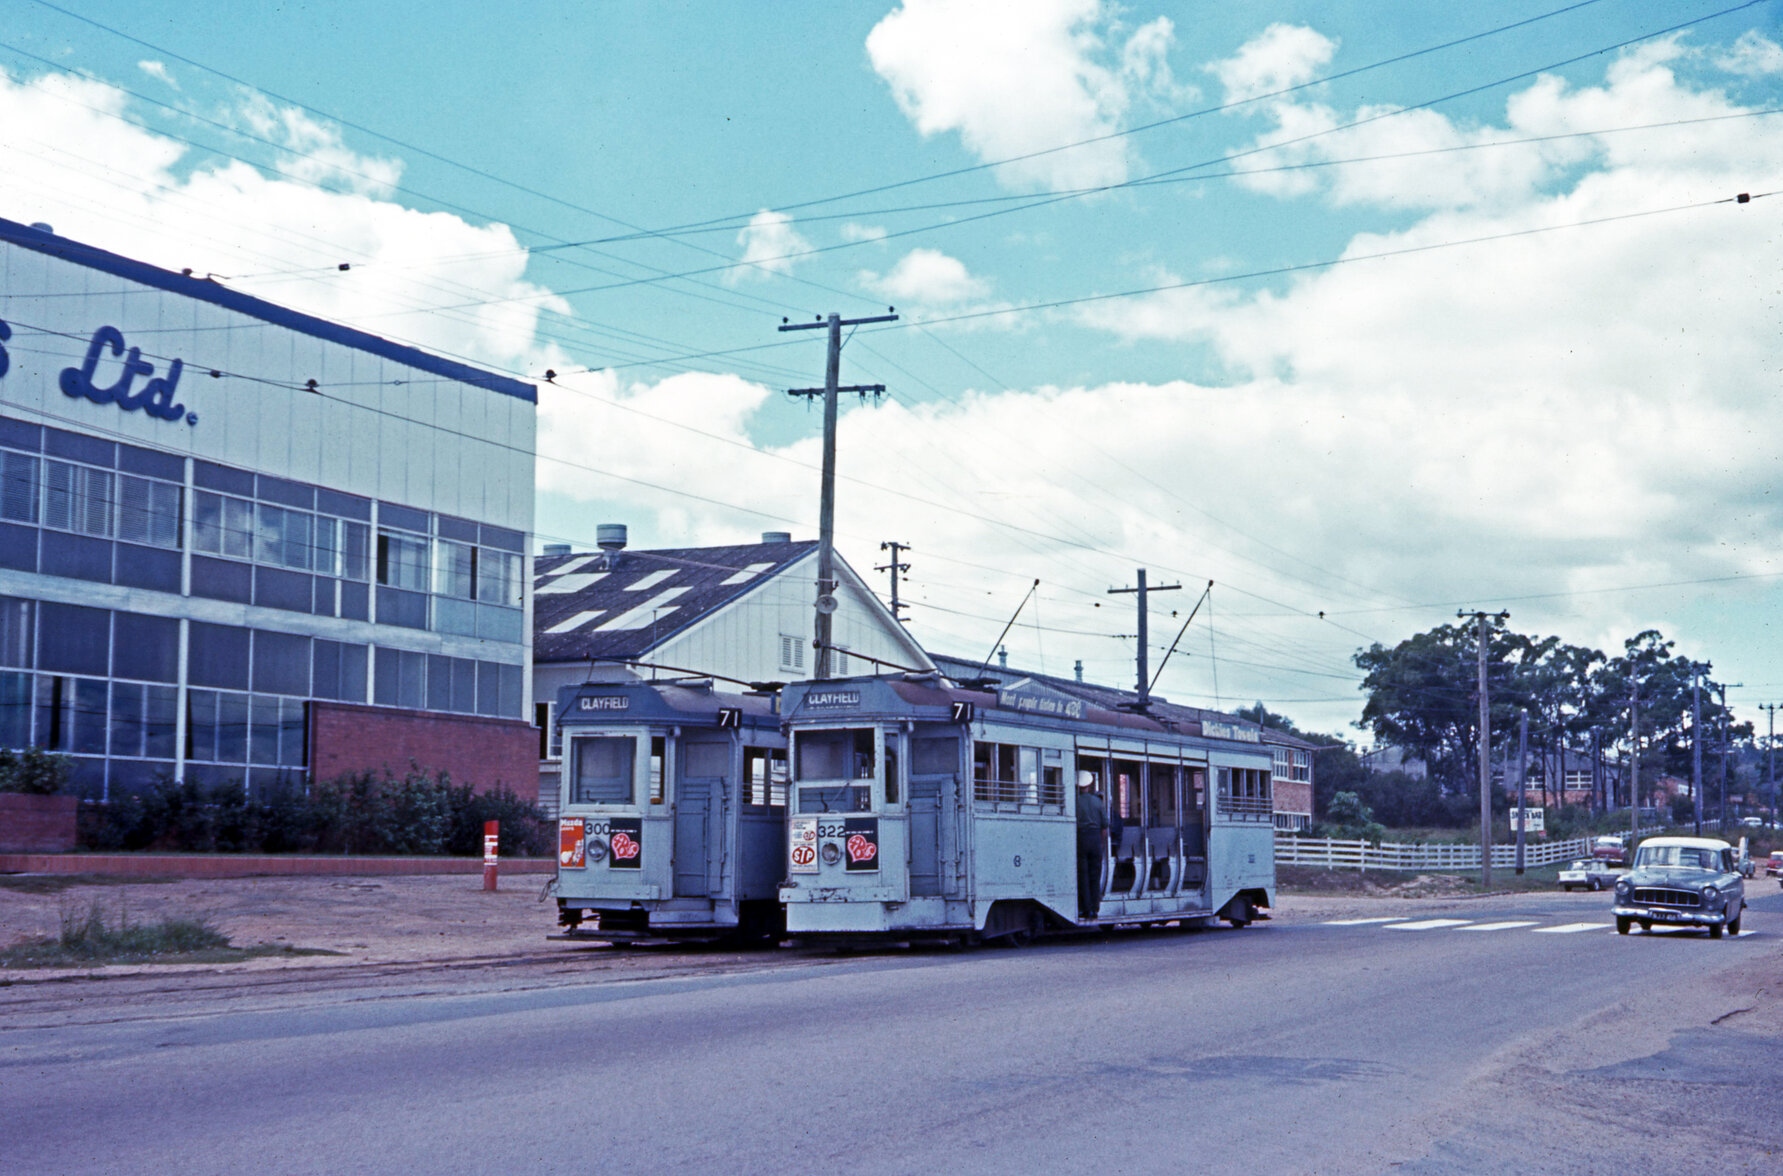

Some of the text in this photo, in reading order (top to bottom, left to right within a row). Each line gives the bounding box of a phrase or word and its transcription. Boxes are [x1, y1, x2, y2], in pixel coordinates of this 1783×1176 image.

[59, 325, 198, 427] Ltd.
[581, 696, 629, 710] CLAYFIELD
[808, 693, 859, 705] CLAYFIELD
[720, 709, 739, 727] 71
[953, 702, 971, 720] 71
[585, 823, 610, 835] 300
[818, 825, 845, 838] 322
[794, 847, 813, 863] STP
